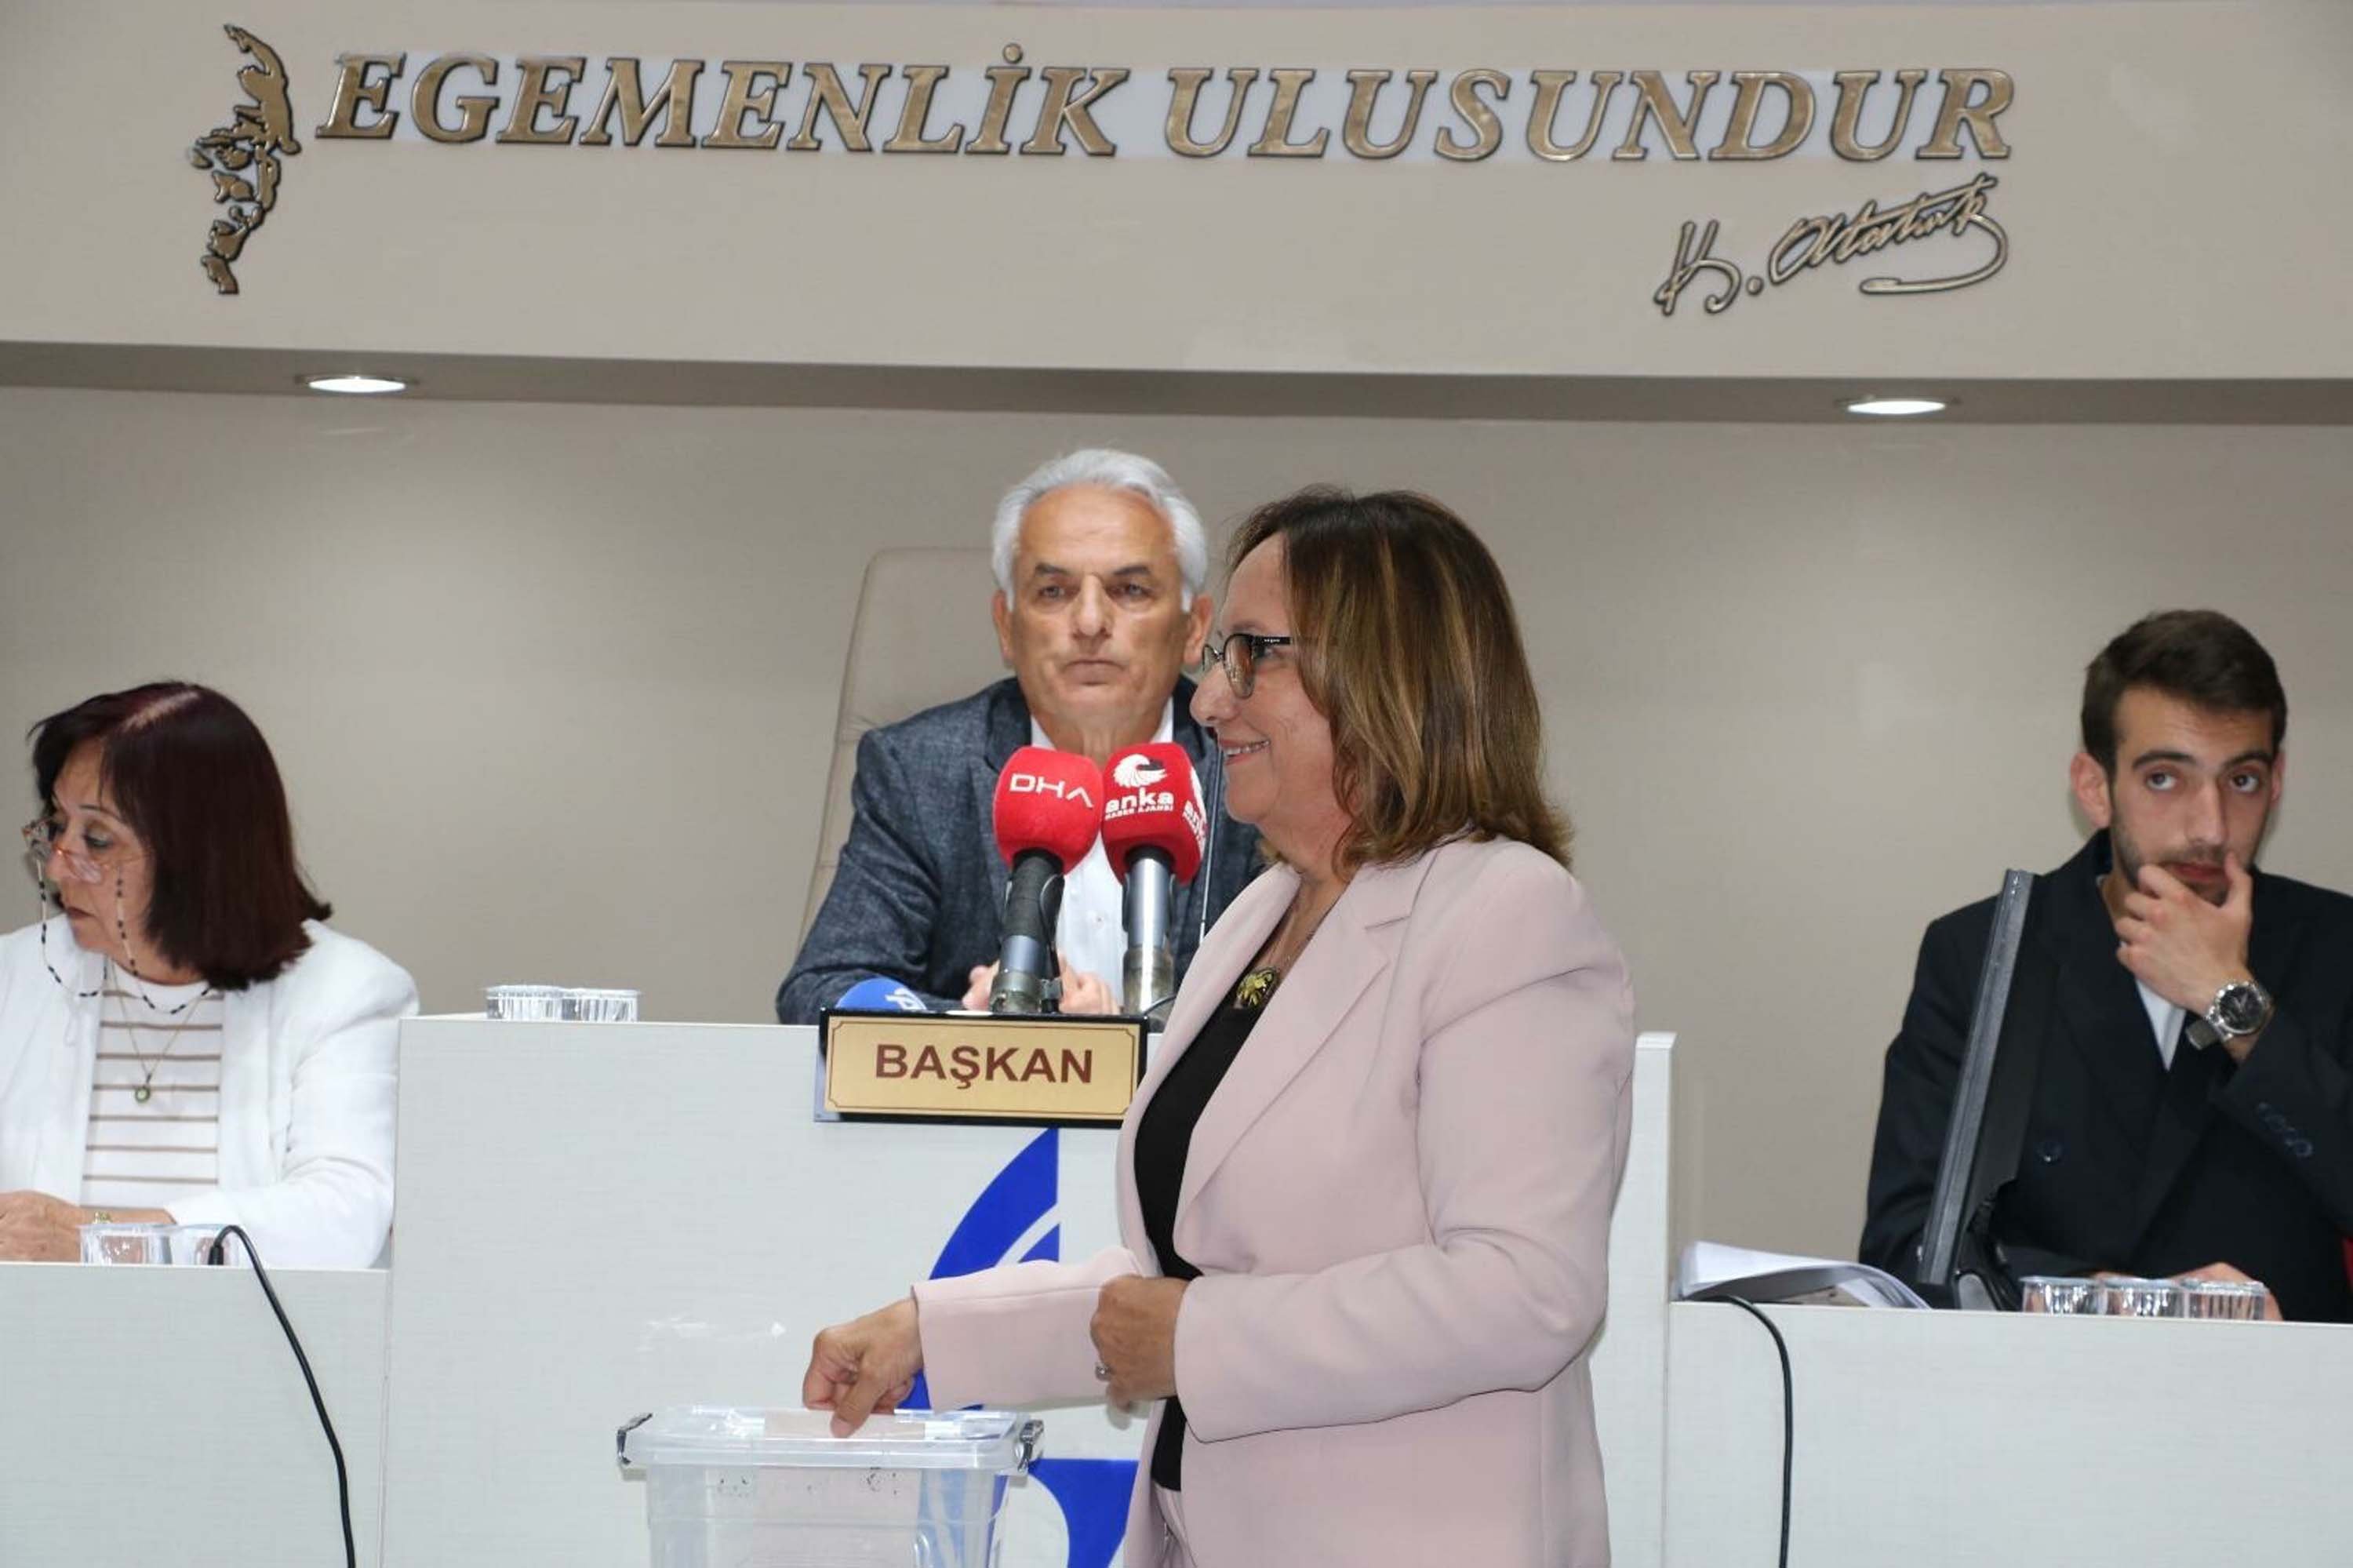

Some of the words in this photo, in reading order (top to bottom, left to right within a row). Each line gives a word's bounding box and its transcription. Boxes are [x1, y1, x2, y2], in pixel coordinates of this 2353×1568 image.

[315, 43, 1131, 156] EGEMENLİK
[1164, 67, 2014, 162] ULUSUNDUR
[1009, 773, 1094, 809] DHA
[1104, 787, 1174, 815] anka
[875, 1044, 1093, 1090] BAŞKAN
